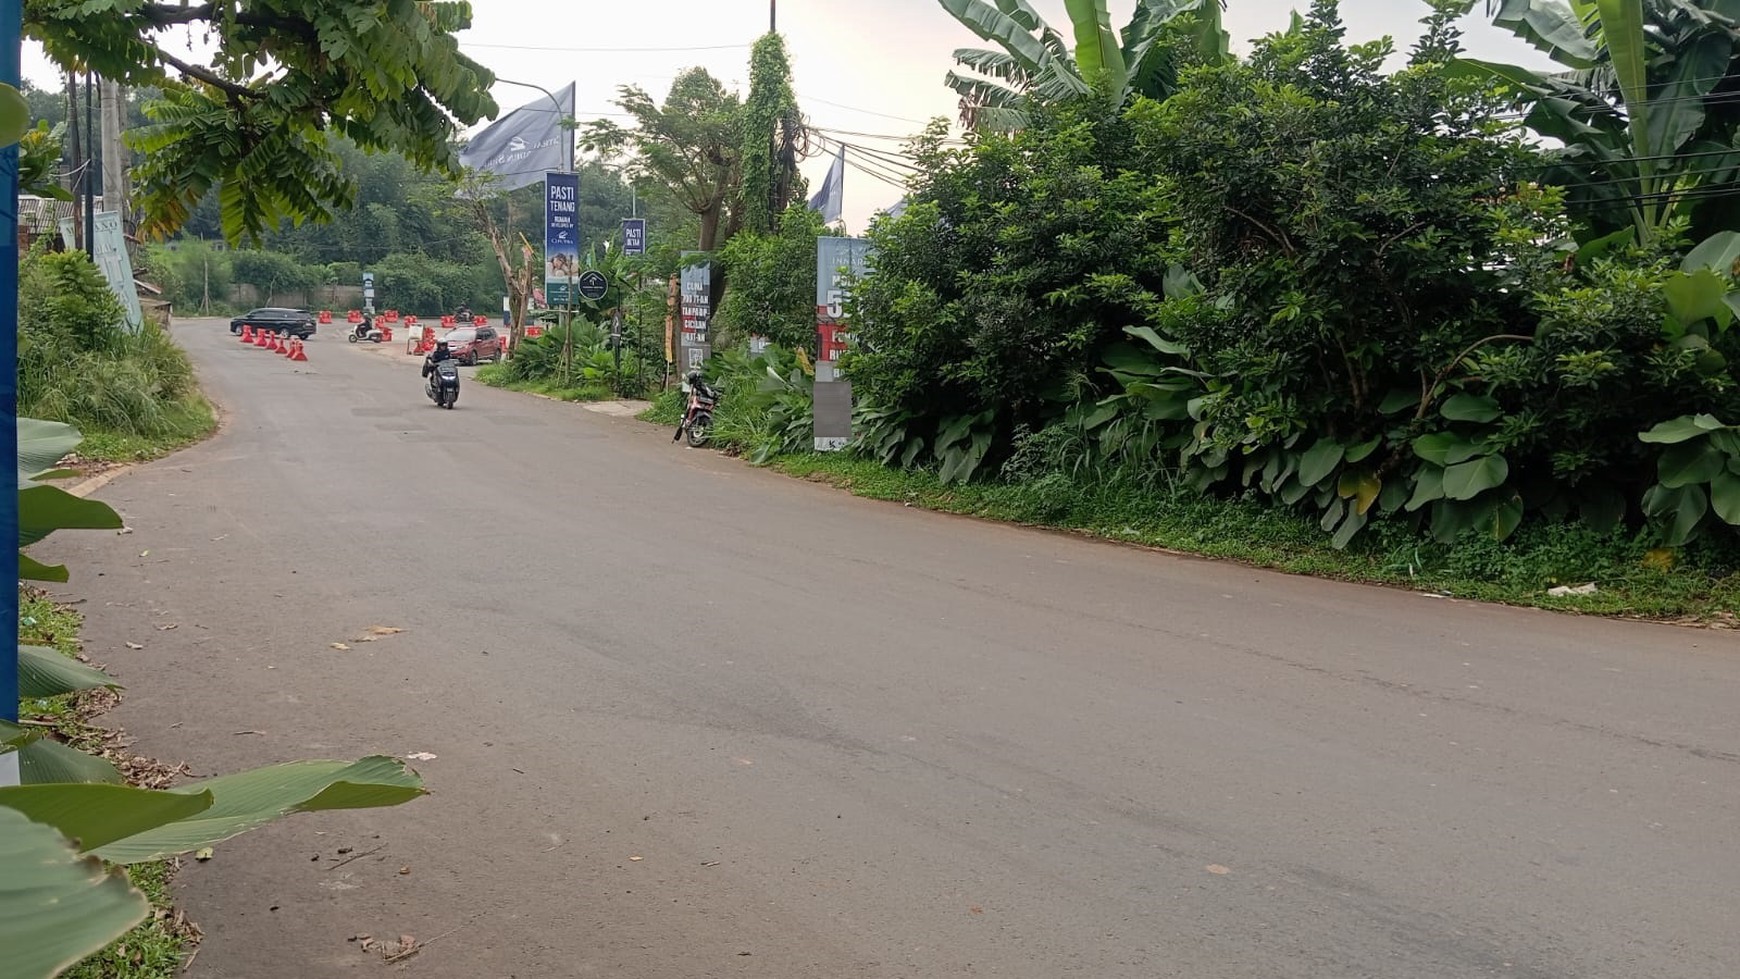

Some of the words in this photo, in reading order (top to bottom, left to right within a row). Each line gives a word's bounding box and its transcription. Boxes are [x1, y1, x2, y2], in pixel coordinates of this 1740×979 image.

[550, 185, 574, 200] PASTI
[550, 200, 575, 213] TENANG
[625, 229, 641, 238] PASTI
